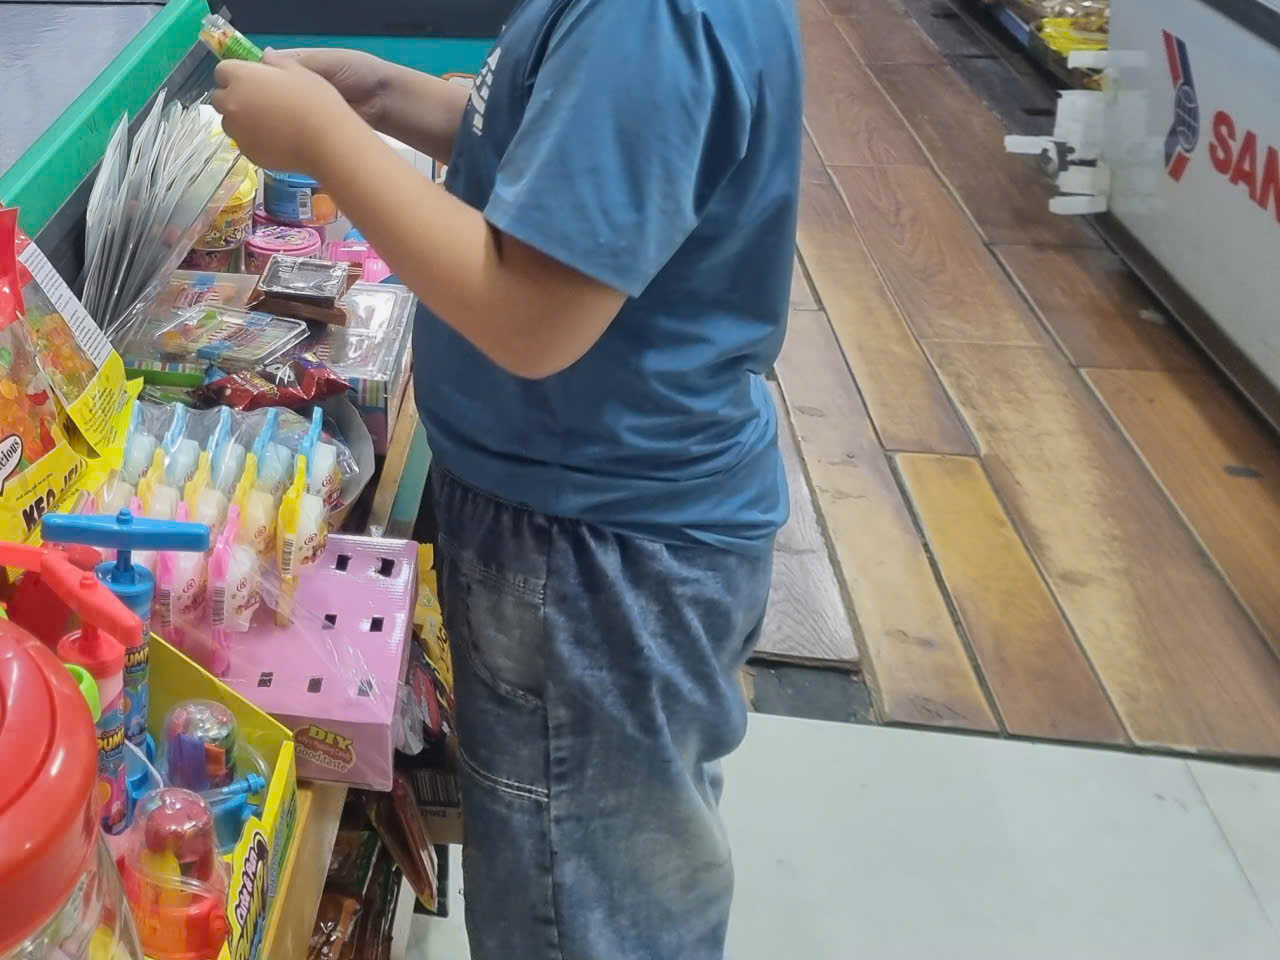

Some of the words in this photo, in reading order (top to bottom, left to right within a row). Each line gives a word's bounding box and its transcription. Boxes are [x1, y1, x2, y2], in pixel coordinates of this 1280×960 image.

[307, 725, 354, 749] DIY
[294, 743, 320, 762] Good
[320, 751, 349, 773] taste
